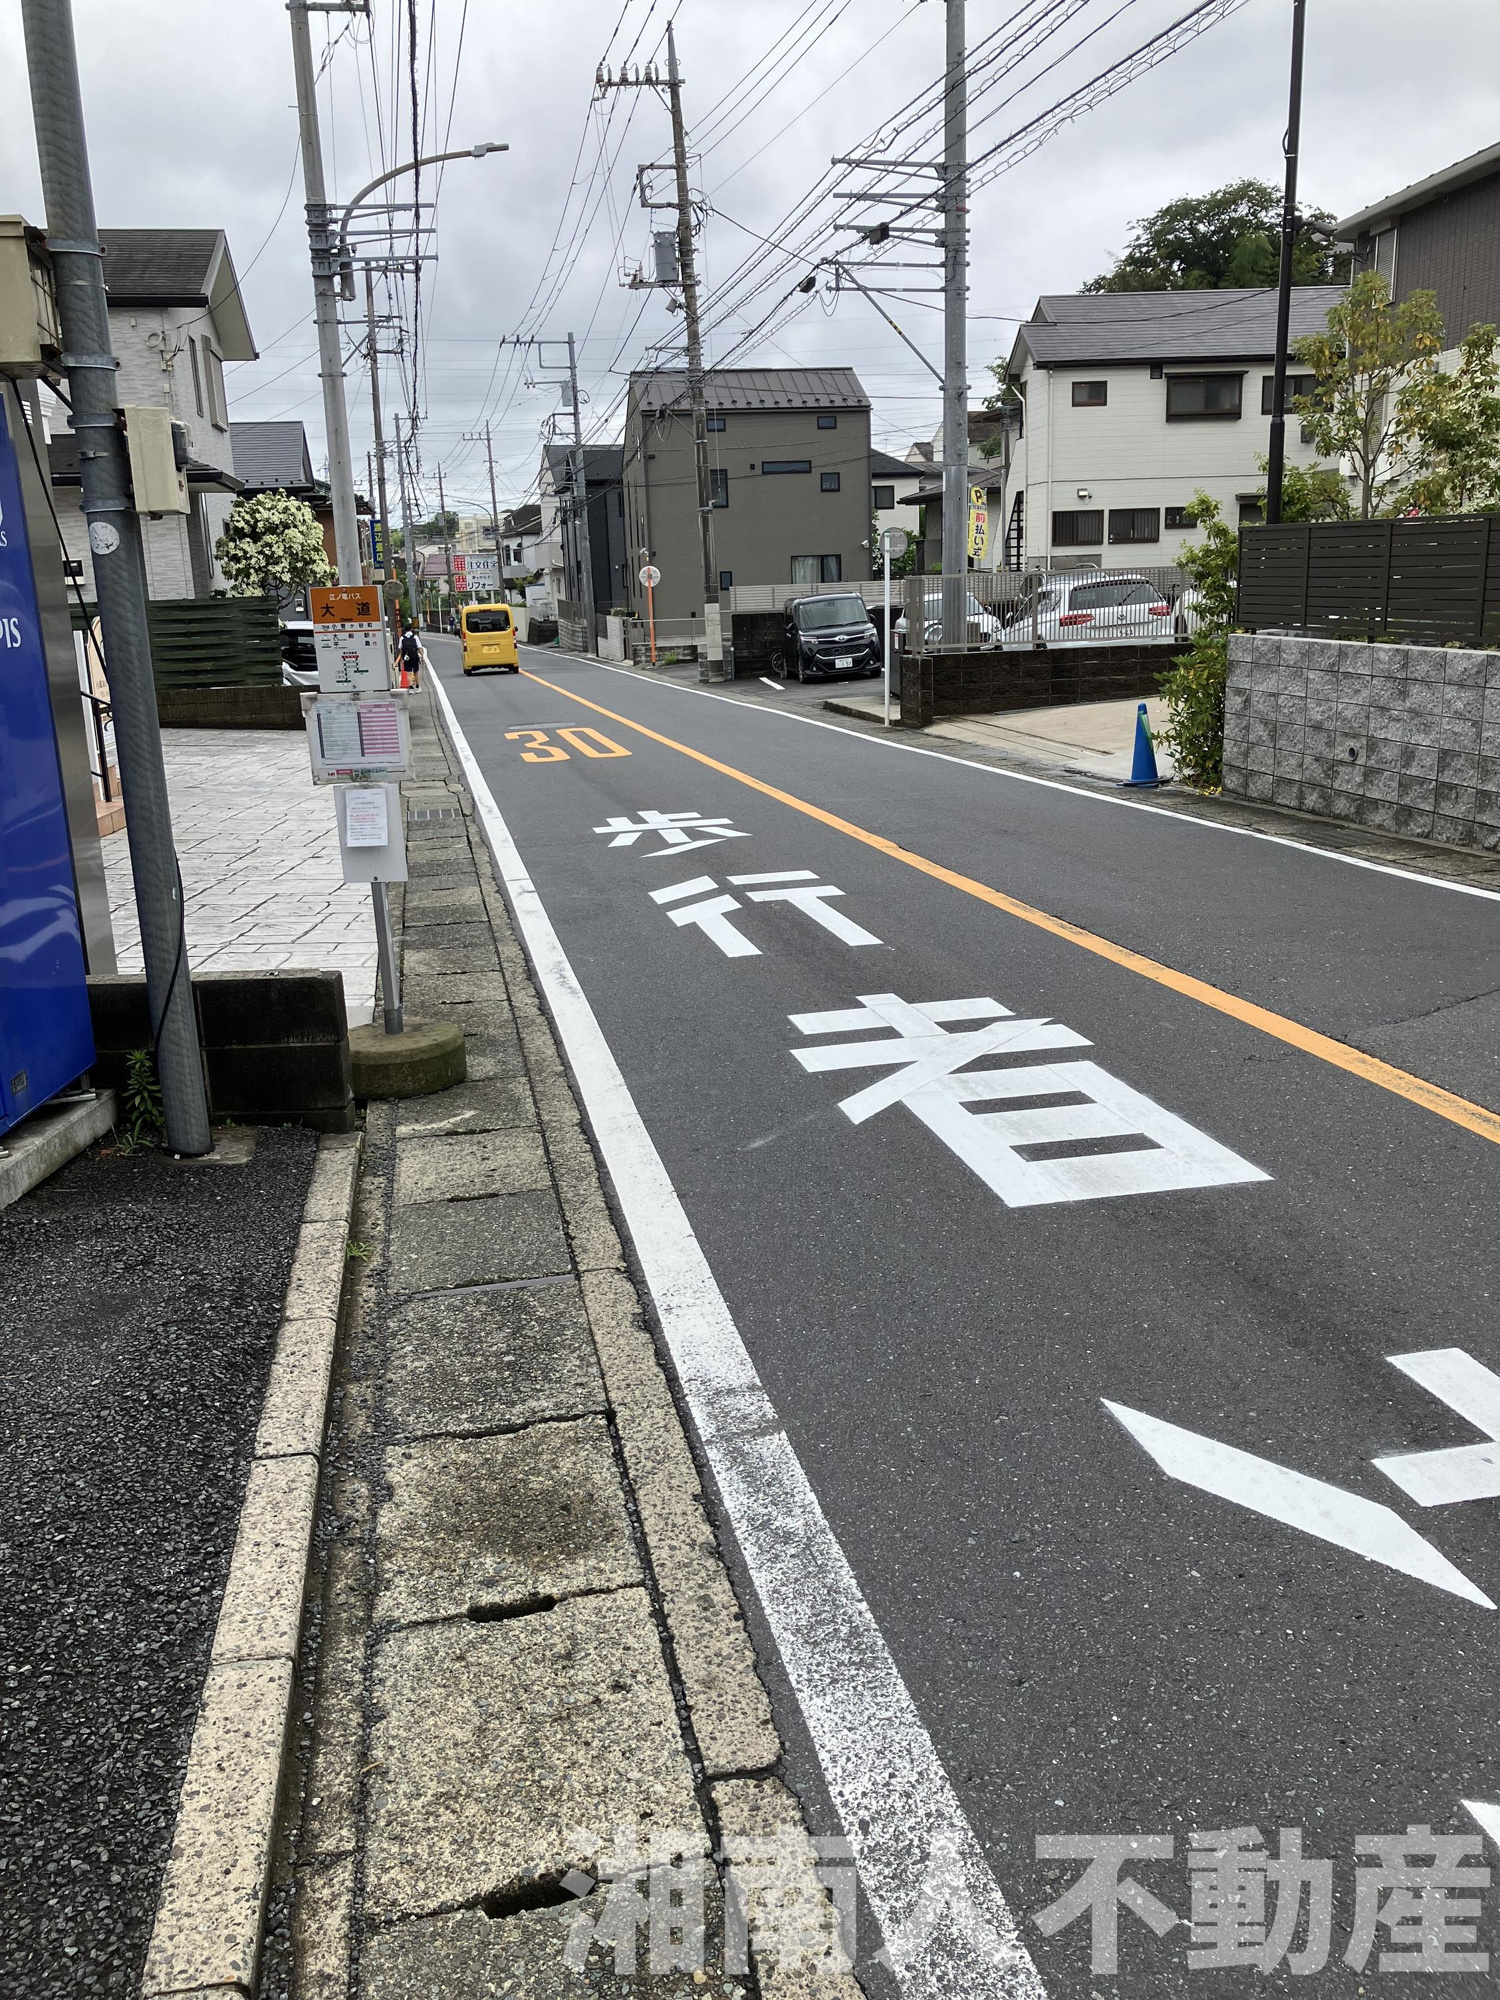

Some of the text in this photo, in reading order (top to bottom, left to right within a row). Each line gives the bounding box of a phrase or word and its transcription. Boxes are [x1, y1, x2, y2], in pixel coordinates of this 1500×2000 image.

[974, 489, 983, 503] P
[972, 512, 986, 557] 前払い式
[329, 592, 362, 601] 江ノ電バス
[320, 601, 372, 618] 大道
[503, 727, 633, 763] 30
